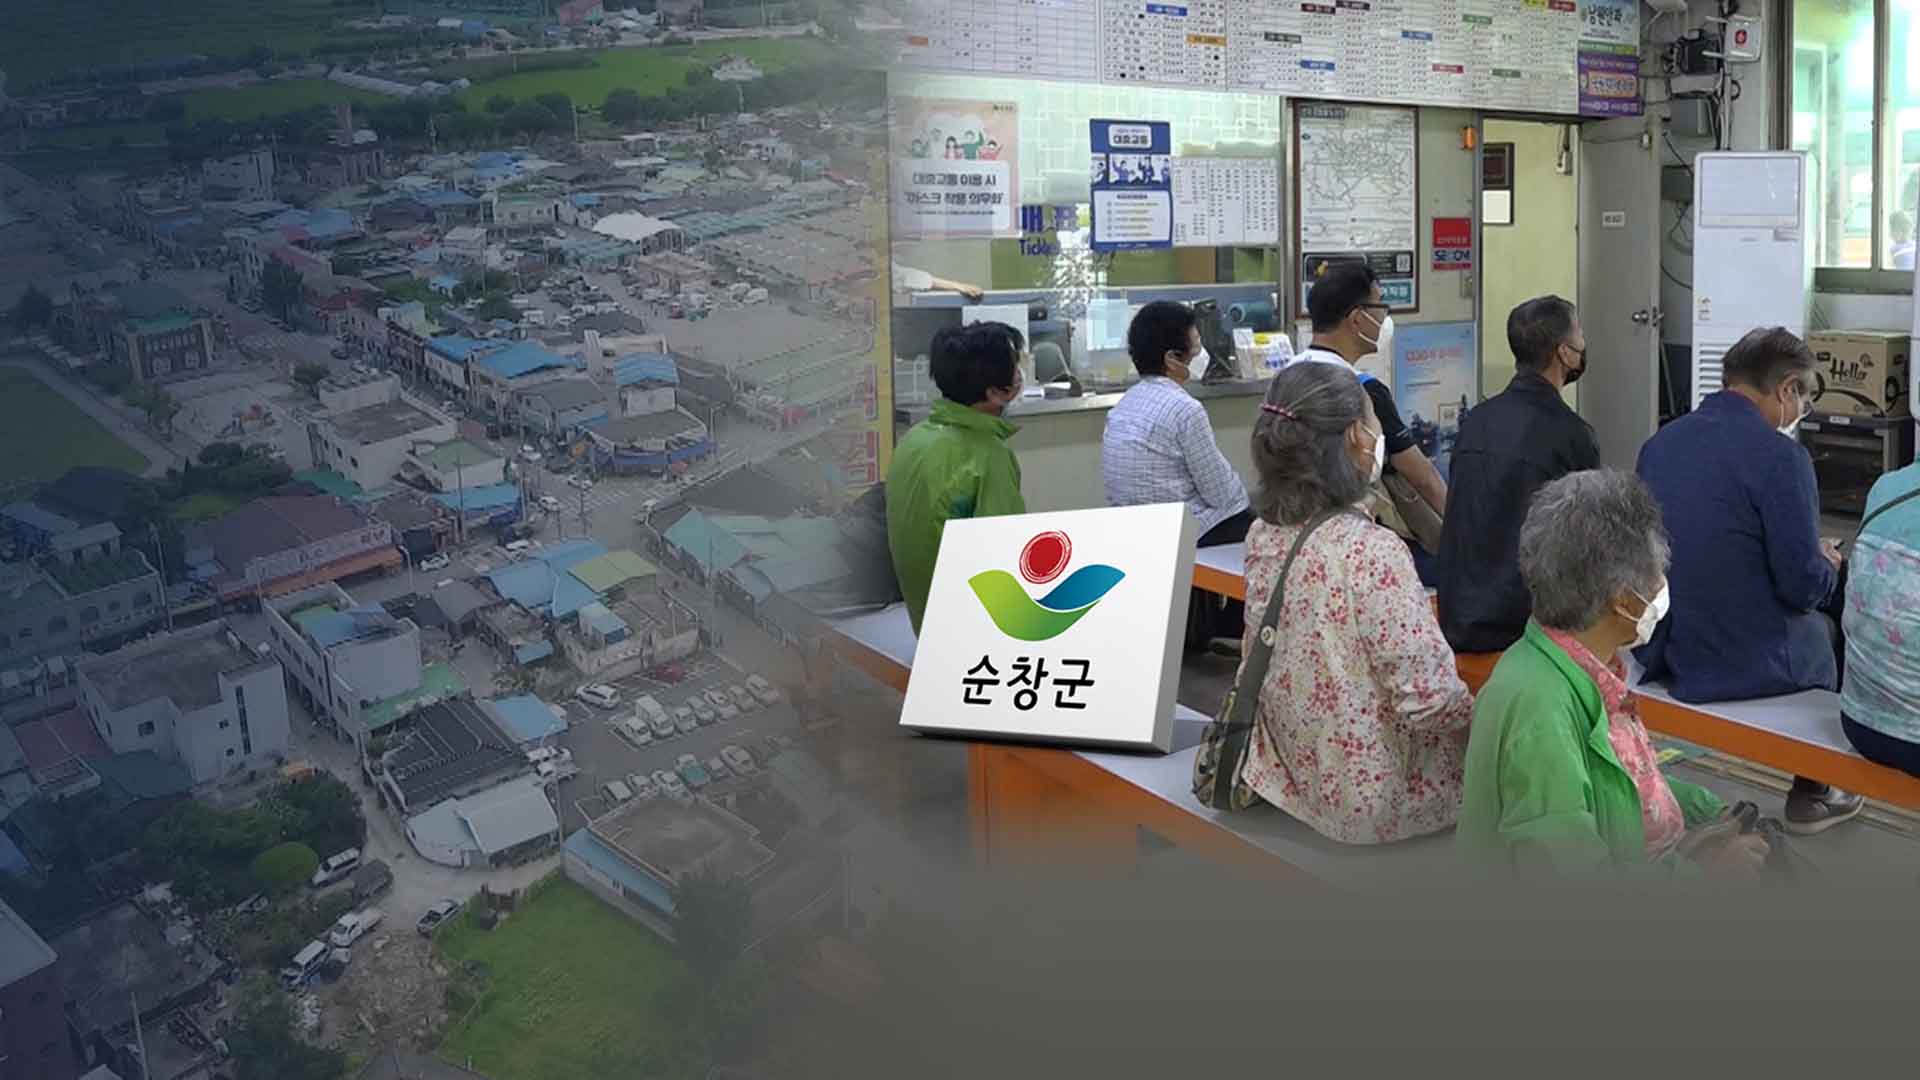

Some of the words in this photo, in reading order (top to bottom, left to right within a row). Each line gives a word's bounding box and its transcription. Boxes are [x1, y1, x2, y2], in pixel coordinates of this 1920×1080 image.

[1113, 134, 1149, 146] 대중교통
[912, 172, 958, 186] 대중교통
[959, 172, 983, 186] 이용
[985, 173, 997, 186] 시
